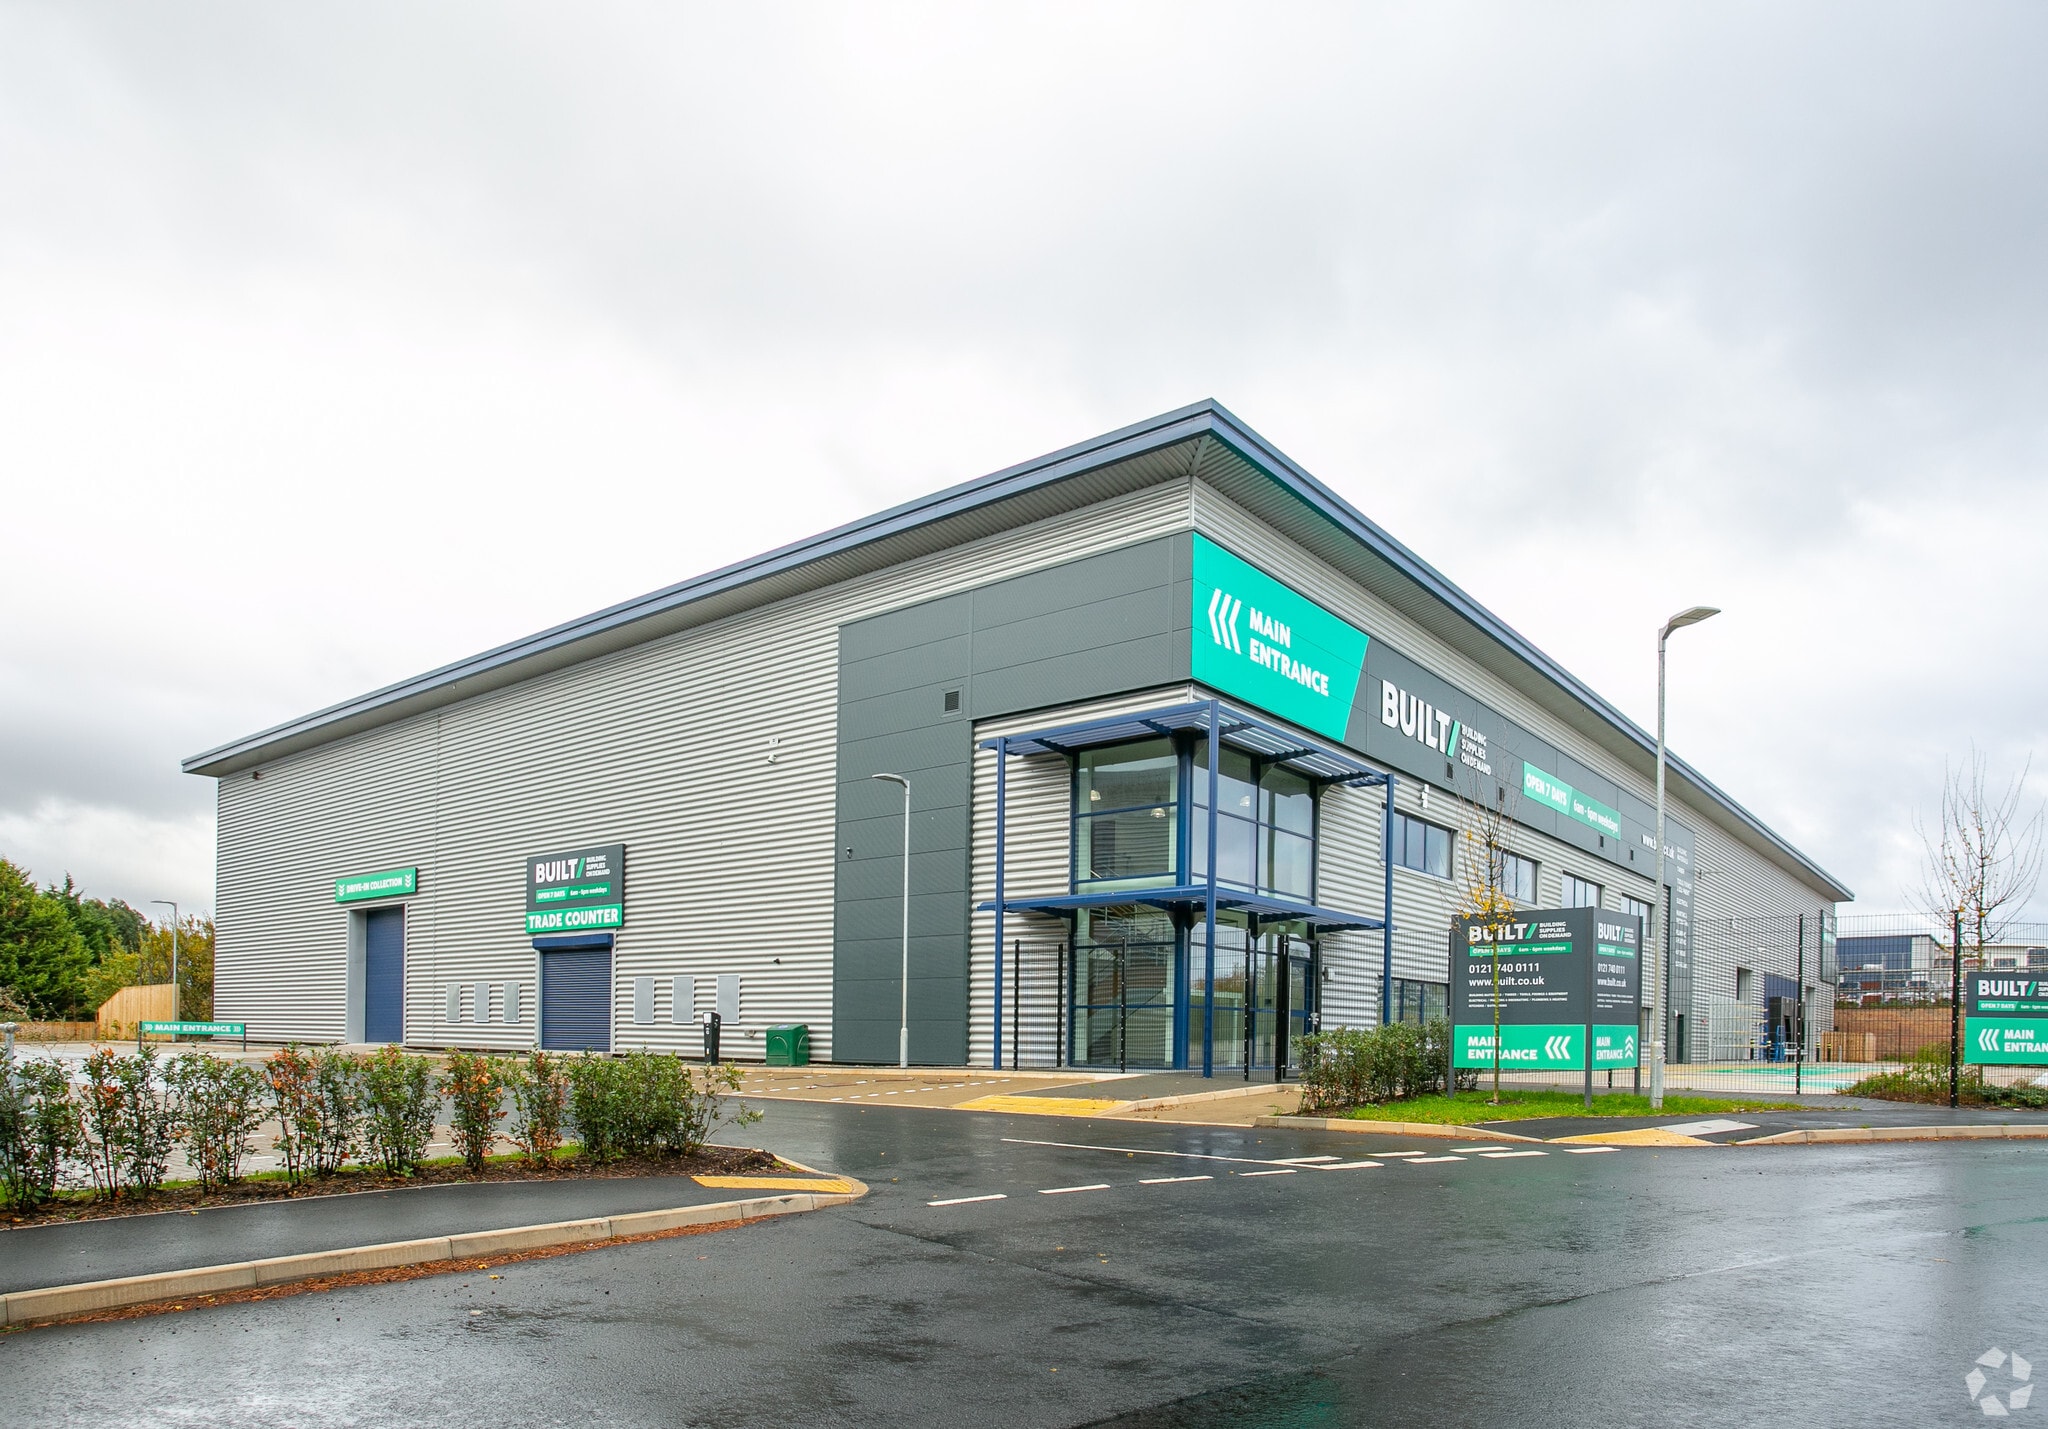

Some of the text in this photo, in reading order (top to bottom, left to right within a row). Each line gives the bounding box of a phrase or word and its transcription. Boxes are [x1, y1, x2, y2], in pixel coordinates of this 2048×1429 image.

[1250, 606, 1290, 648] MAIN
[1250, 637, 1329, 697] ENTRANCE
[1526, 772, 1567, 806] OPEN 7 DAYS
[370, 877, 403, 890] COLLECTION
[528, 908, 619, 929] TRADE COUNTER
[1468, 964, 1492, 974] 0121
[1515, 963, 1539, 972] 0111
[182, 1024, 231, 1032] ENTRANCE
[2004, 1029, 2034, 1040] MAIN
[1596, 1036, 1611, 1046] MAIN
[1596, 1050, 1623, 1060] ENTRANCE
